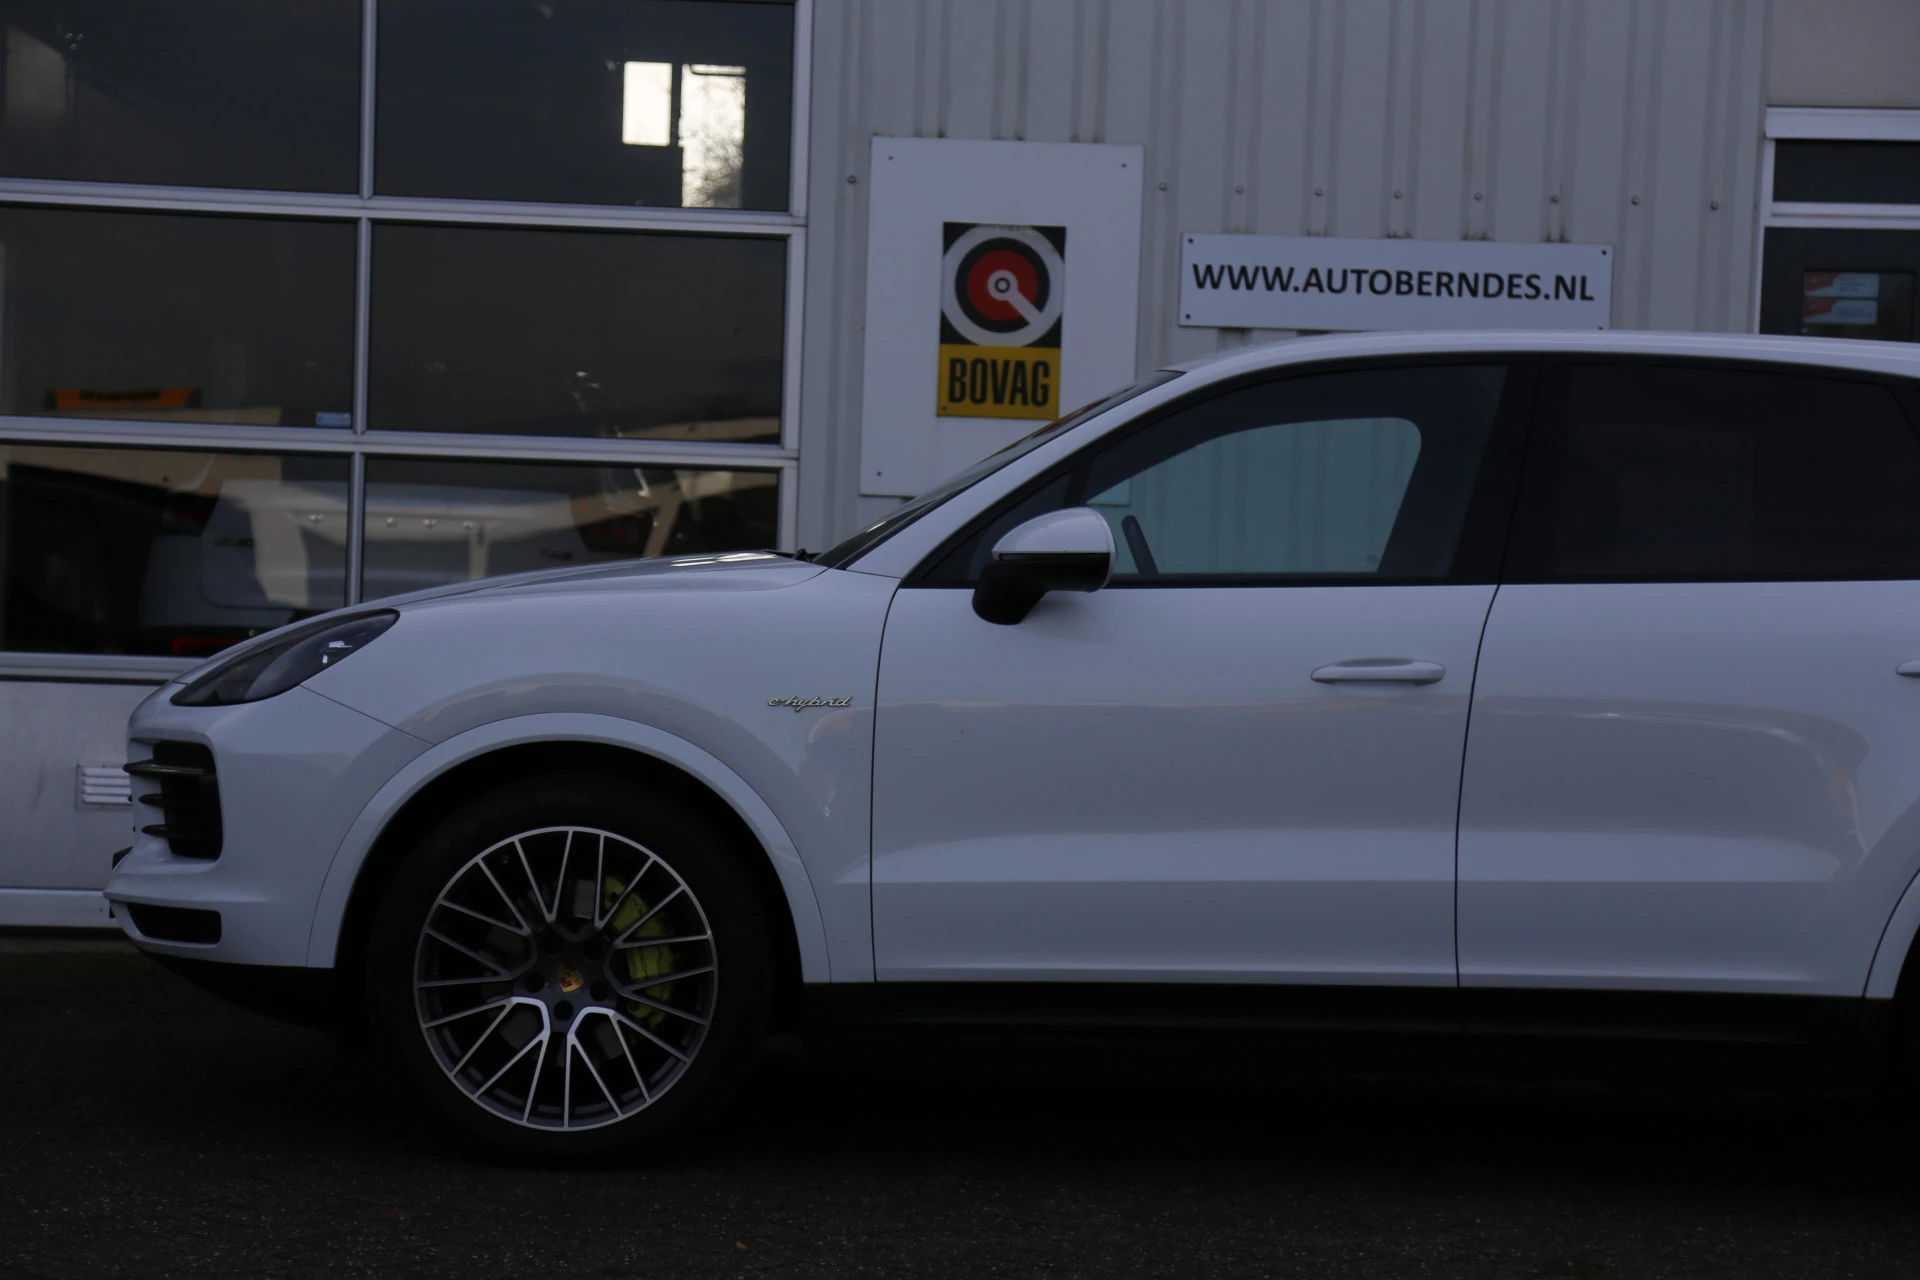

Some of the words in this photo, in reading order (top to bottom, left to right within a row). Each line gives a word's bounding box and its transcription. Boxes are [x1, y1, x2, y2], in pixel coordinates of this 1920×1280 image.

[1193, 264, 1595, 301] WWW.AUTOBERNDES.NL
[948, 357, 1050, 407] BOVAG
[768, 695, 853, 713] e-hybrid
